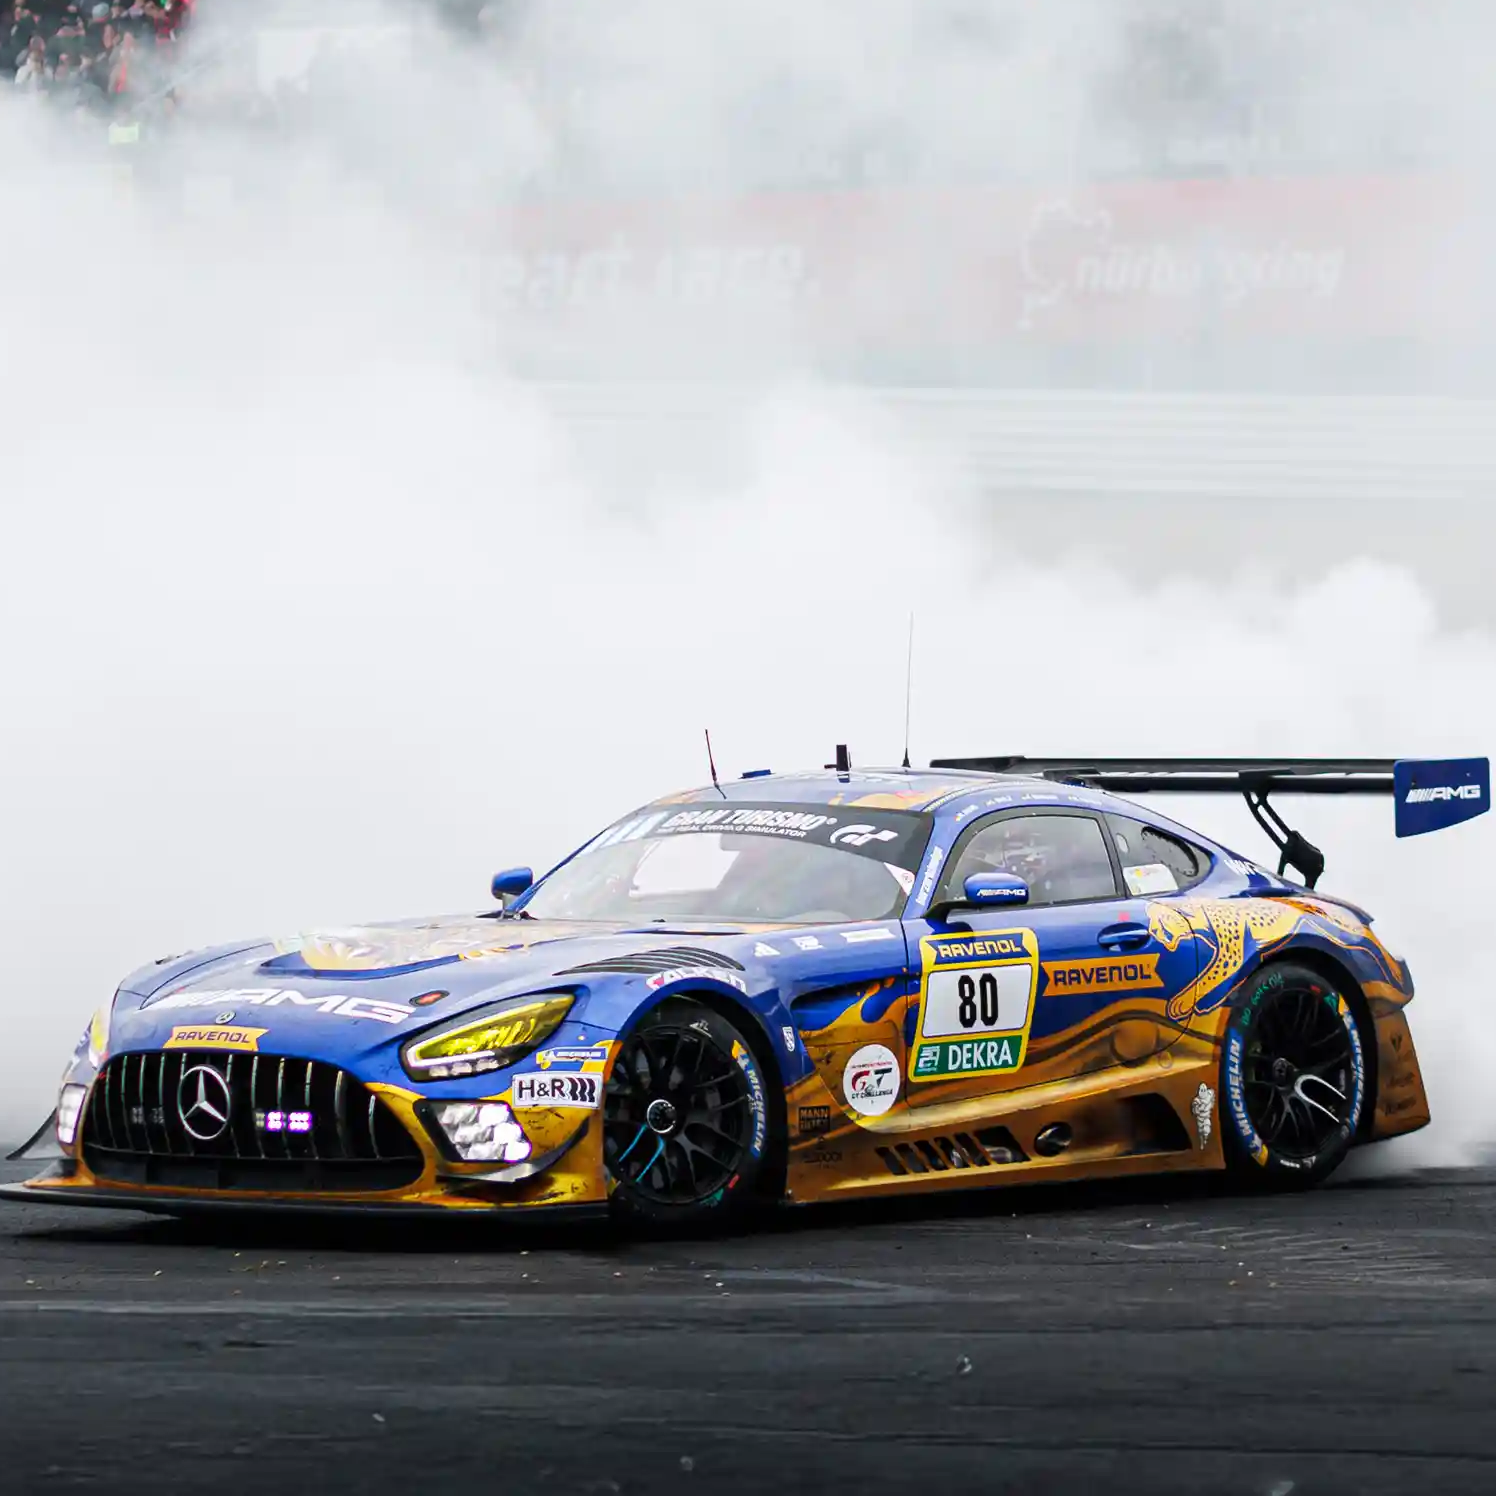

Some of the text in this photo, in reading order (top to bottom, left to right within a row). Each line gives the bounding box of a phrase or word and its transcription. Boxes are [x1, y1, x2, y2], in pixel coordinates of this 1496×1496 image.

[1424, 784, 1481, 802] AMG
[661, 809, 732, 827] GRAN
[937, 939, 1022, 958] RAVENOL
[1052, 964, 1152, 987] RAVENOL
[220, 988, 417, 1025] AMG
[957, 972, 999, 1029] 80
[174, 1030, 252, 1044] RAVENOL
[947, 1039, 1013, 1071] DEKRA
[518, 1078, 566, 1099] H&R
[1229, 1039, 1253, 1137] MICHELIN
[747, 1070, 766, 1152] MICHELIN
